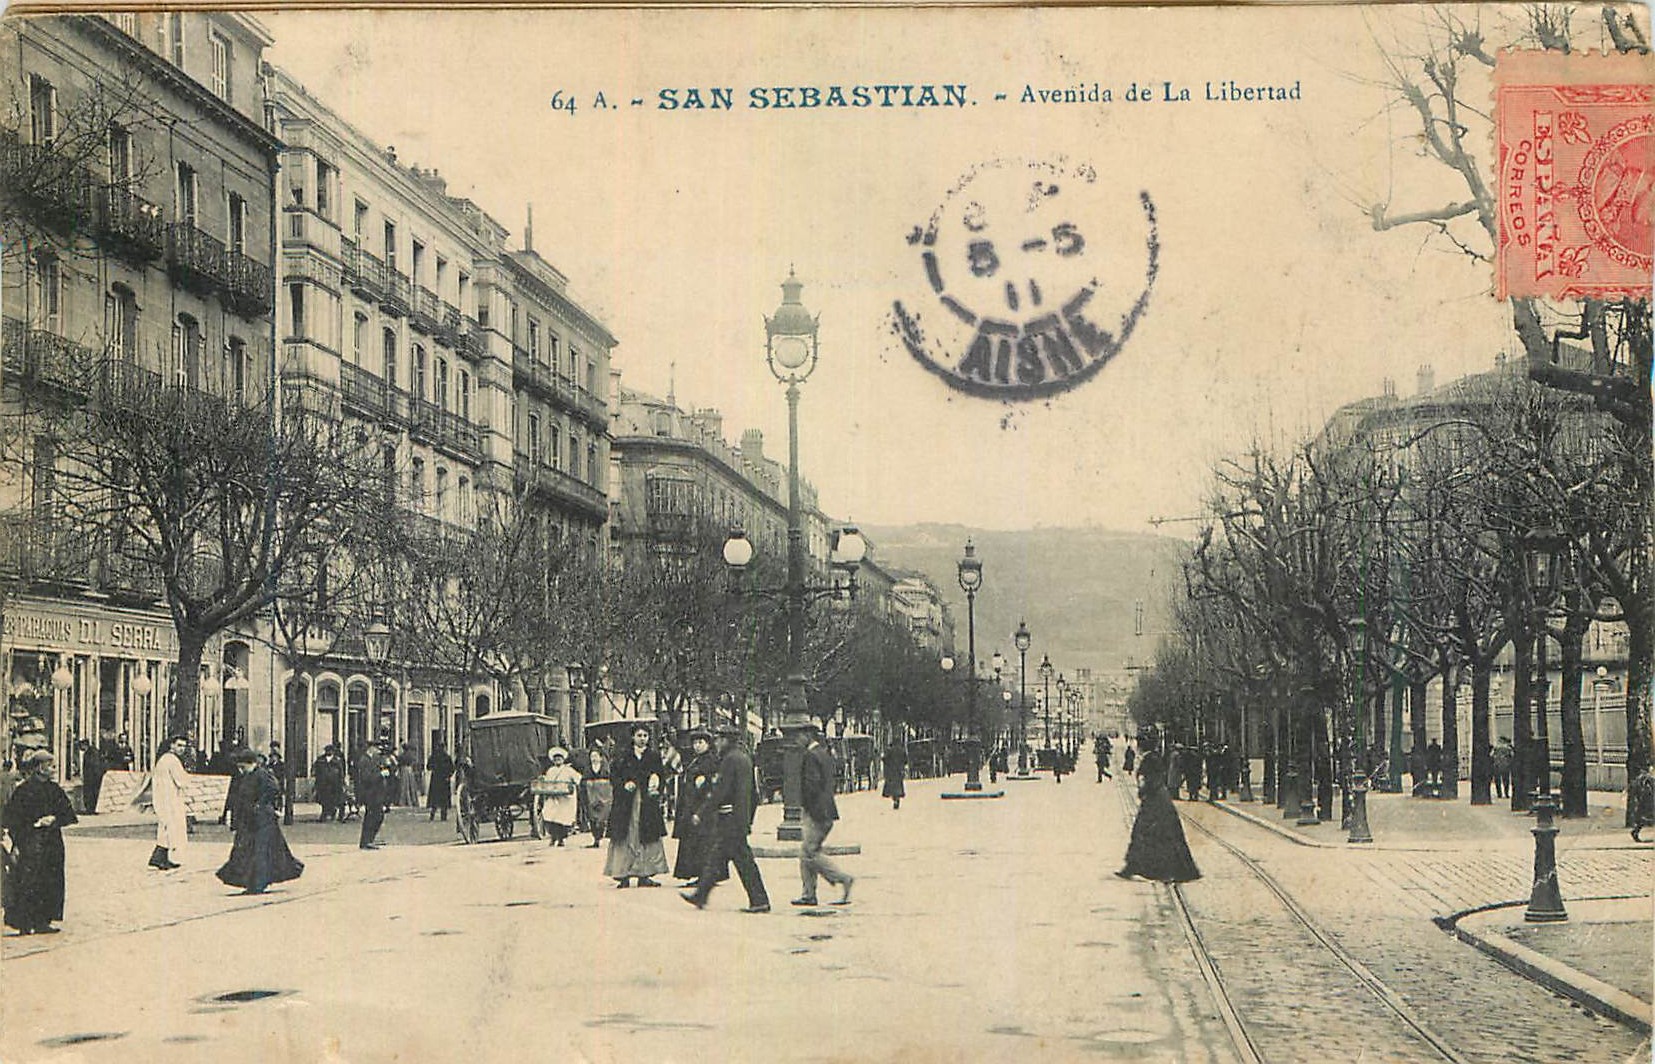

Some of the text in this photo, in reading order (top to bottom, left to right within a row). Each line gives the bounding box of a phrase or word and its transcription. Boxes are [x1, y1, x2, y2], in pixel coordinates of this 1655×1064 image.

[1509, 139, 1533, 247] CORREOS
[1534, 112, 1559, 281] ESPAÑA
[958, 313, 1113, 377] AISNE
[111, 622, 161, 651] SERRA
